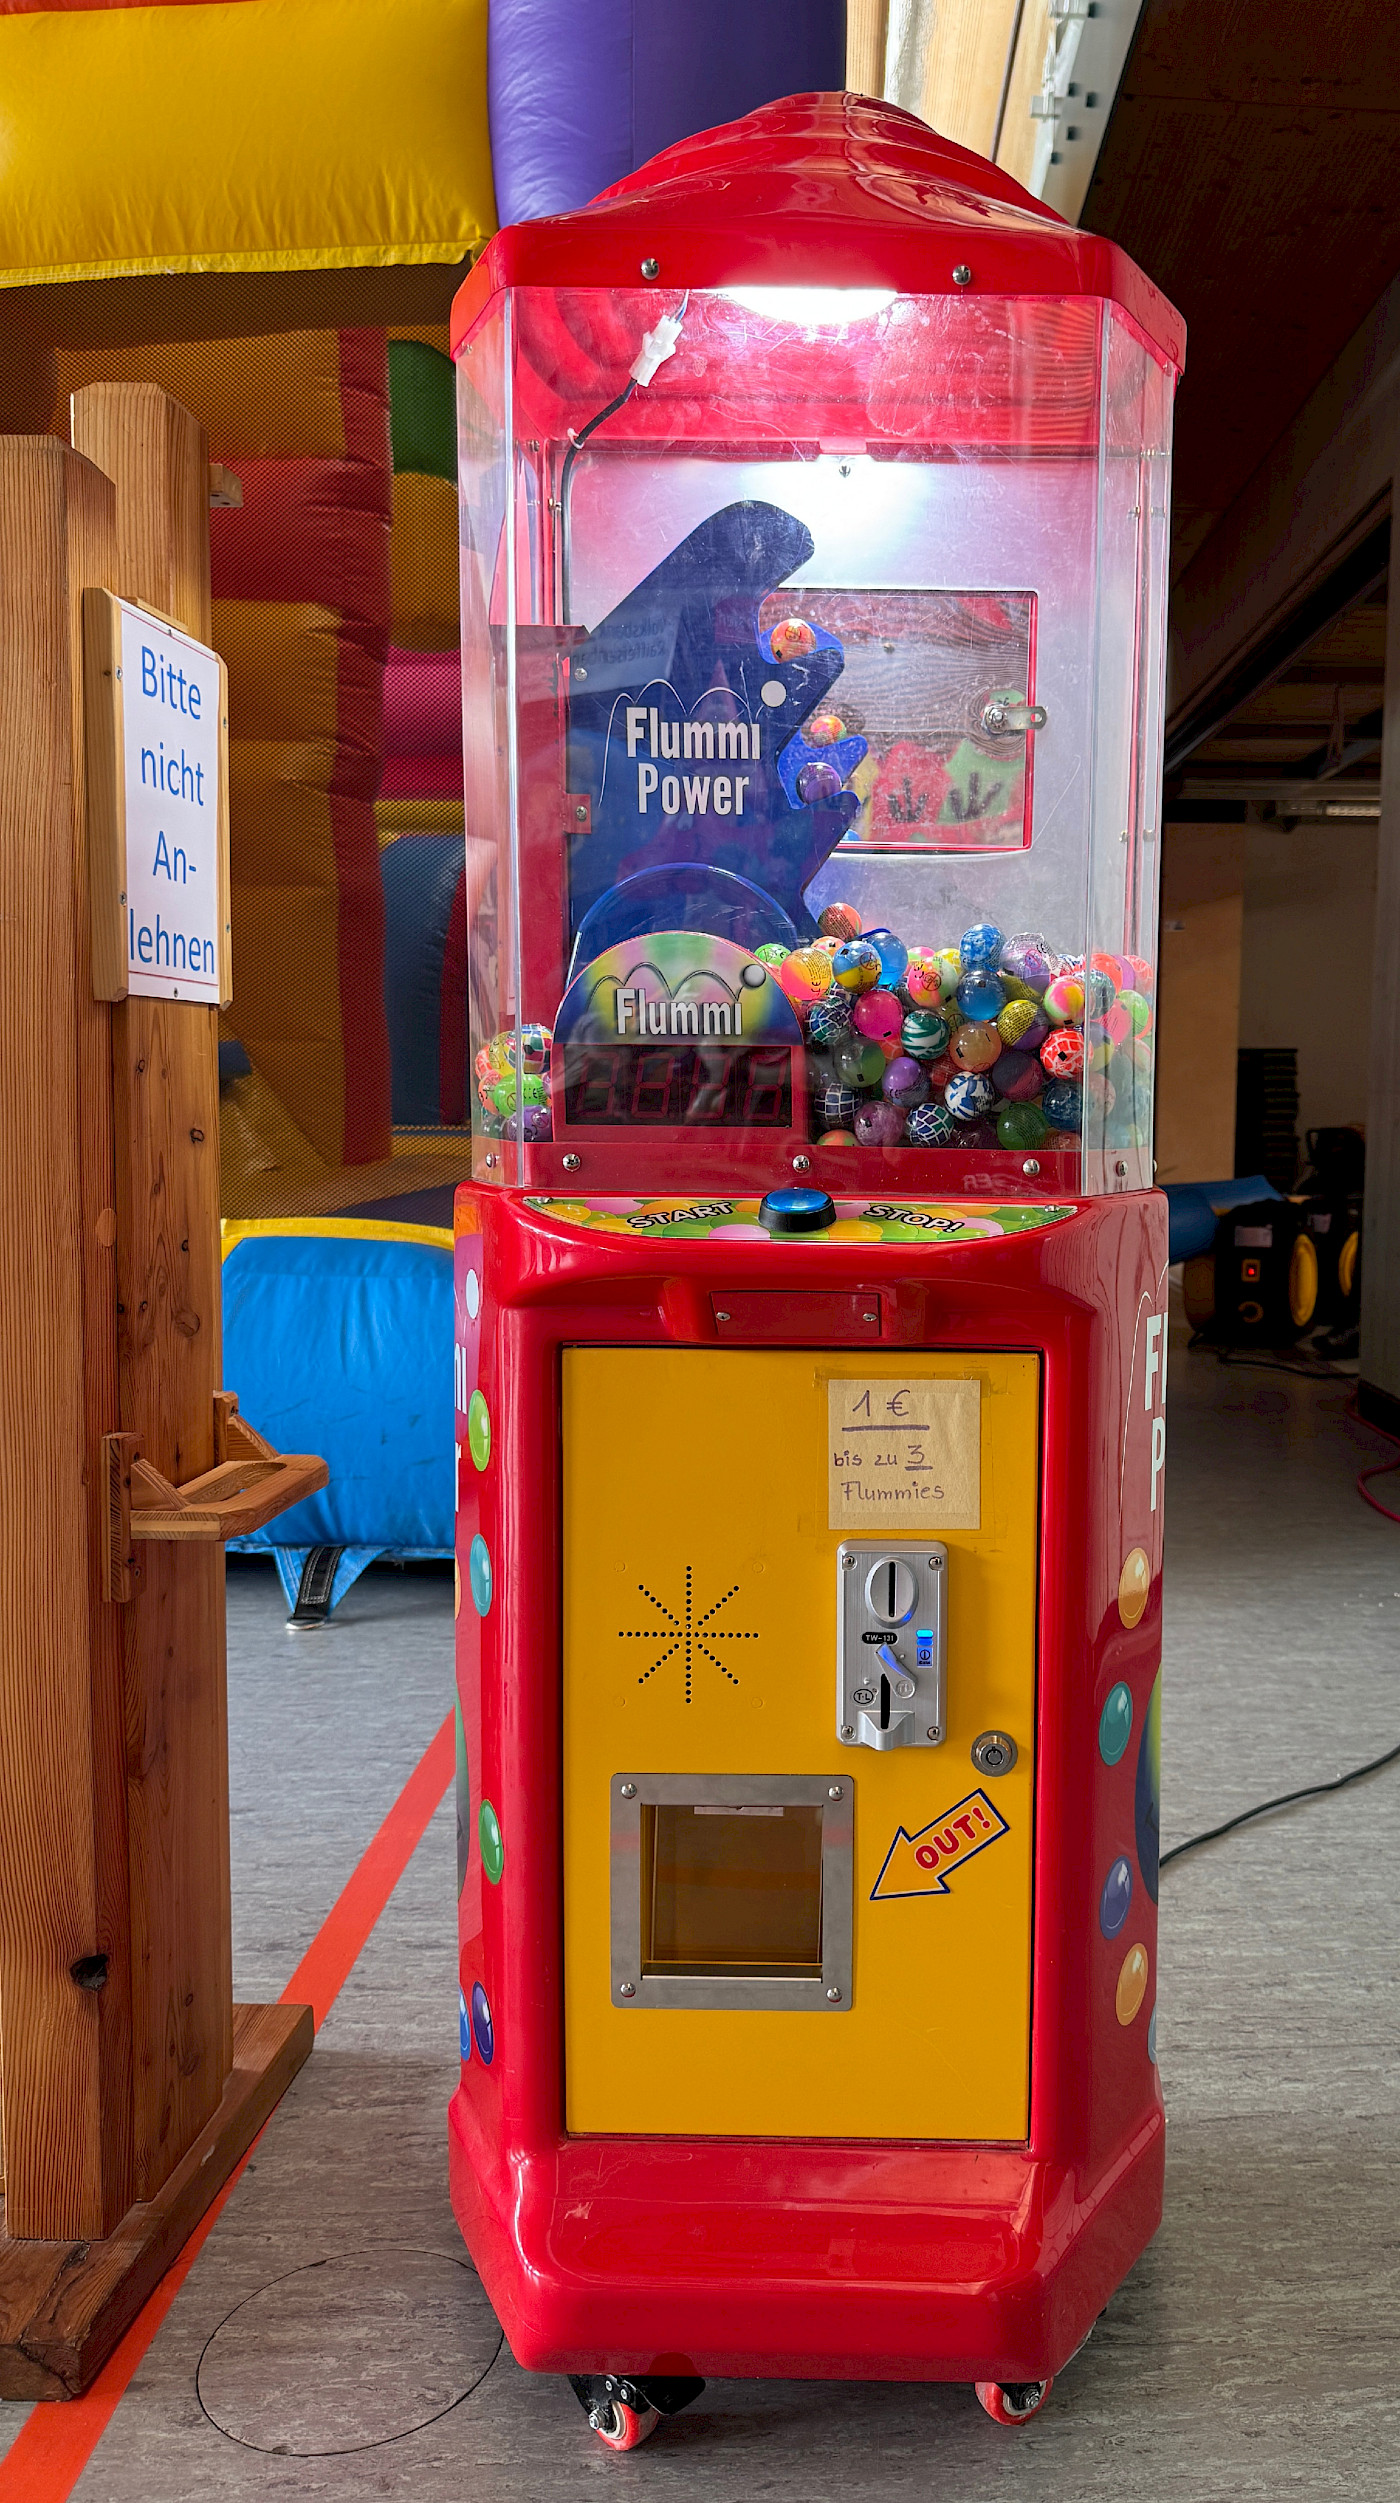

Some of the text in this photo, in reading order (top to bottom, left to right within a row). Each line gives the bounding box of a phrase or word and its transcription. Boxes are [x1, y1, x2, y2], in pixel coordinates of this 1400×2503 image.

[141, 645, 202, 721] Bitte
[626, 706, 761, 760] Flummi
[141, 741, 204, 806] nicht
[637, 763, 750, 815] Power
[152, 830, 198, 885] An-
[129, 908, 215, 975] lehnen
[615, 988, 743, 1036] Flummi
[627, 1200, 733, 1230] START
[865, 1203, 965, 1232] STOP!
[852, 1389, 911, 1417] 1 €
[833, 1444, 926, 1467] bis zu 3
[840, 1480, 945, 1501] Flummies
[865, 1634, 894, 1643] TW-131
[914, 1807, 991, 1870] OUT!
